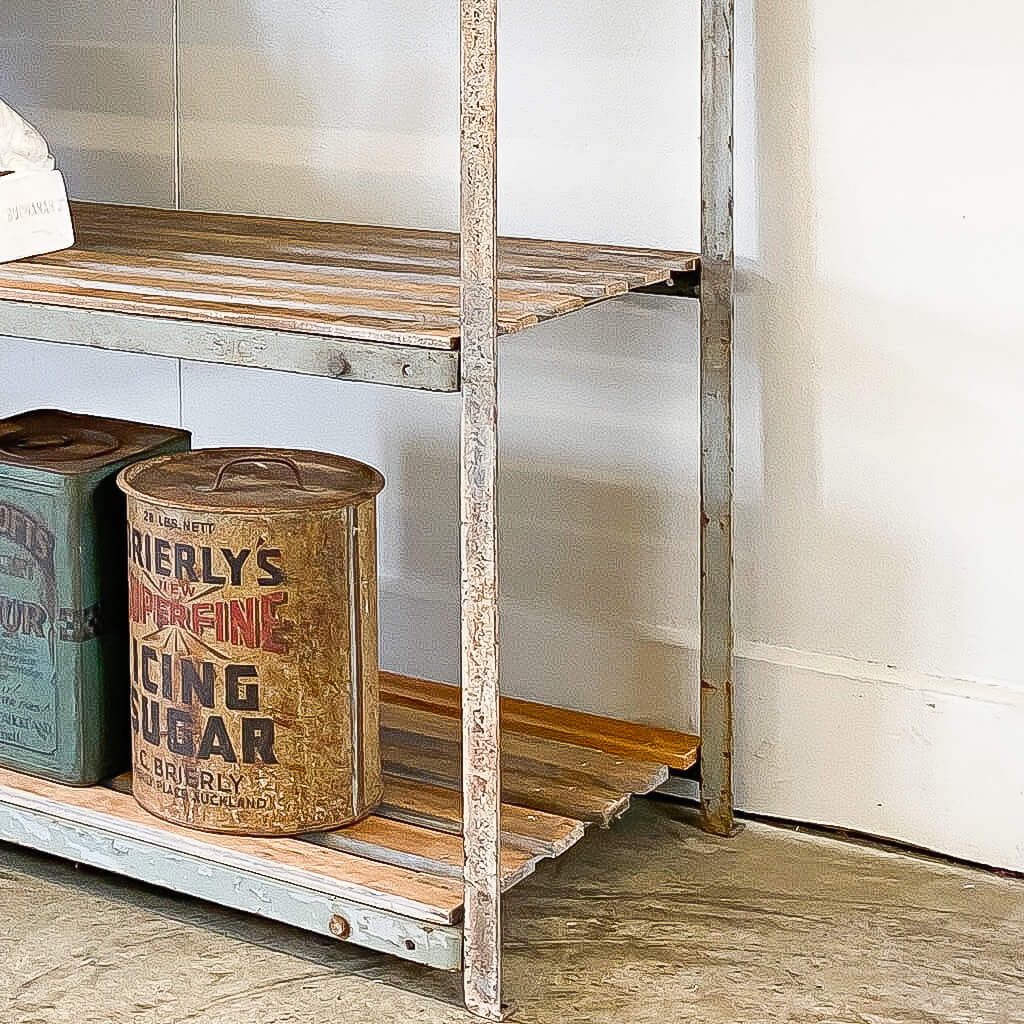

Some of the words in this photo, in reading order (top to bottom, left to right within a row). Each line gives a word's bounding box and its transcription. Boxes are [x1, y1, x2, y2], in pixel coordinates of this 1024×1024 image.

[183, 520, 214, 534] NETT
[127, 525, 282, 586] RIERLY'S
[129, 574, 289, 655] UPERFINE
[132, 638, 259, 711] ICING
[154, 757, 244, 794] BRIERLY
[191, 791, 268, 809] AUCKLAND
